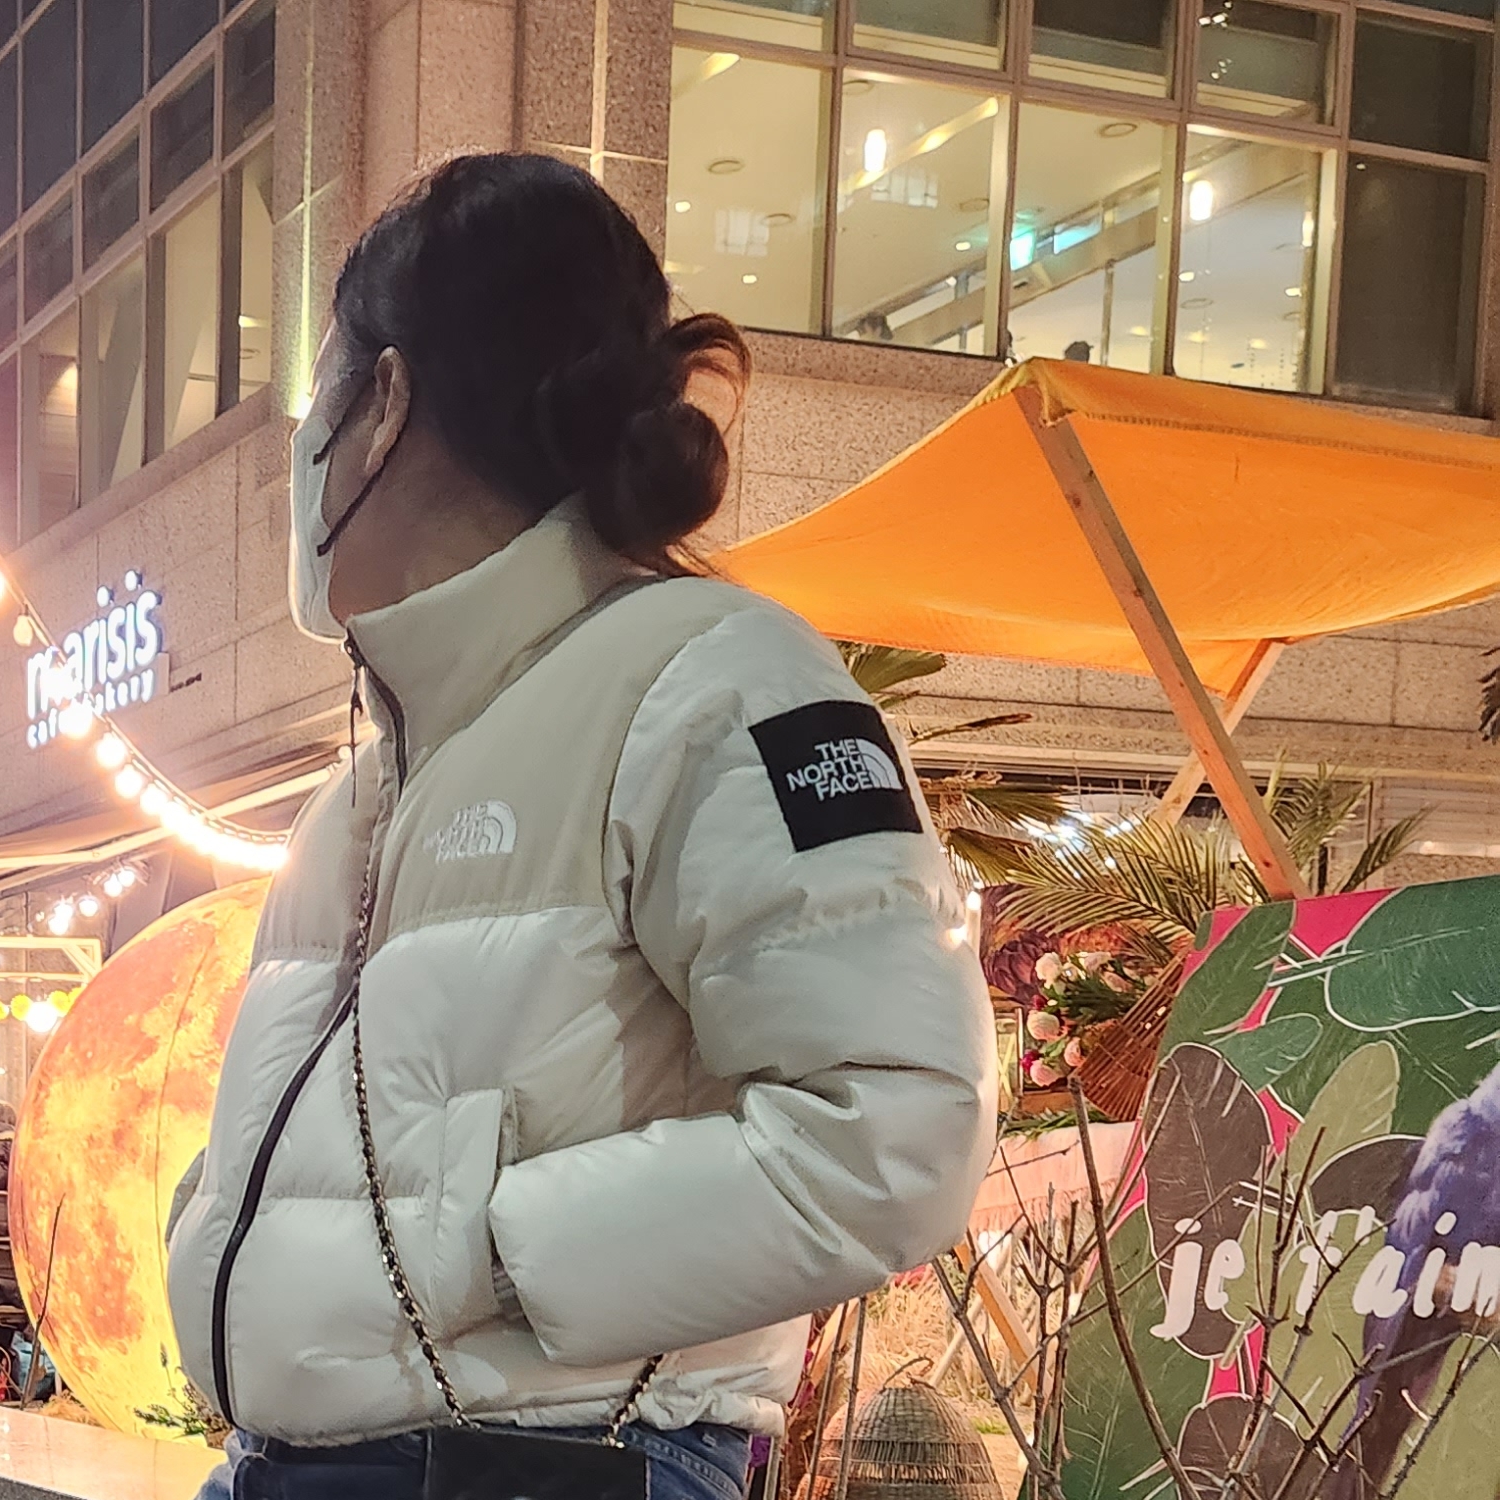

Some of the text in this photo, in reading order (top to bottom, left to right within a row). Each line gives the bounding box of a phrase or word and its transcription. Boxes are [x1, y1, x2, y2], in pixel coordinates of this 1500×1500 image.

[814, 738, 861, 760] THE
[786, 755, 867, 792] NORTH
[815, 771, 874, 801] FACE
[1150, 1217, 1245, 1341] je
